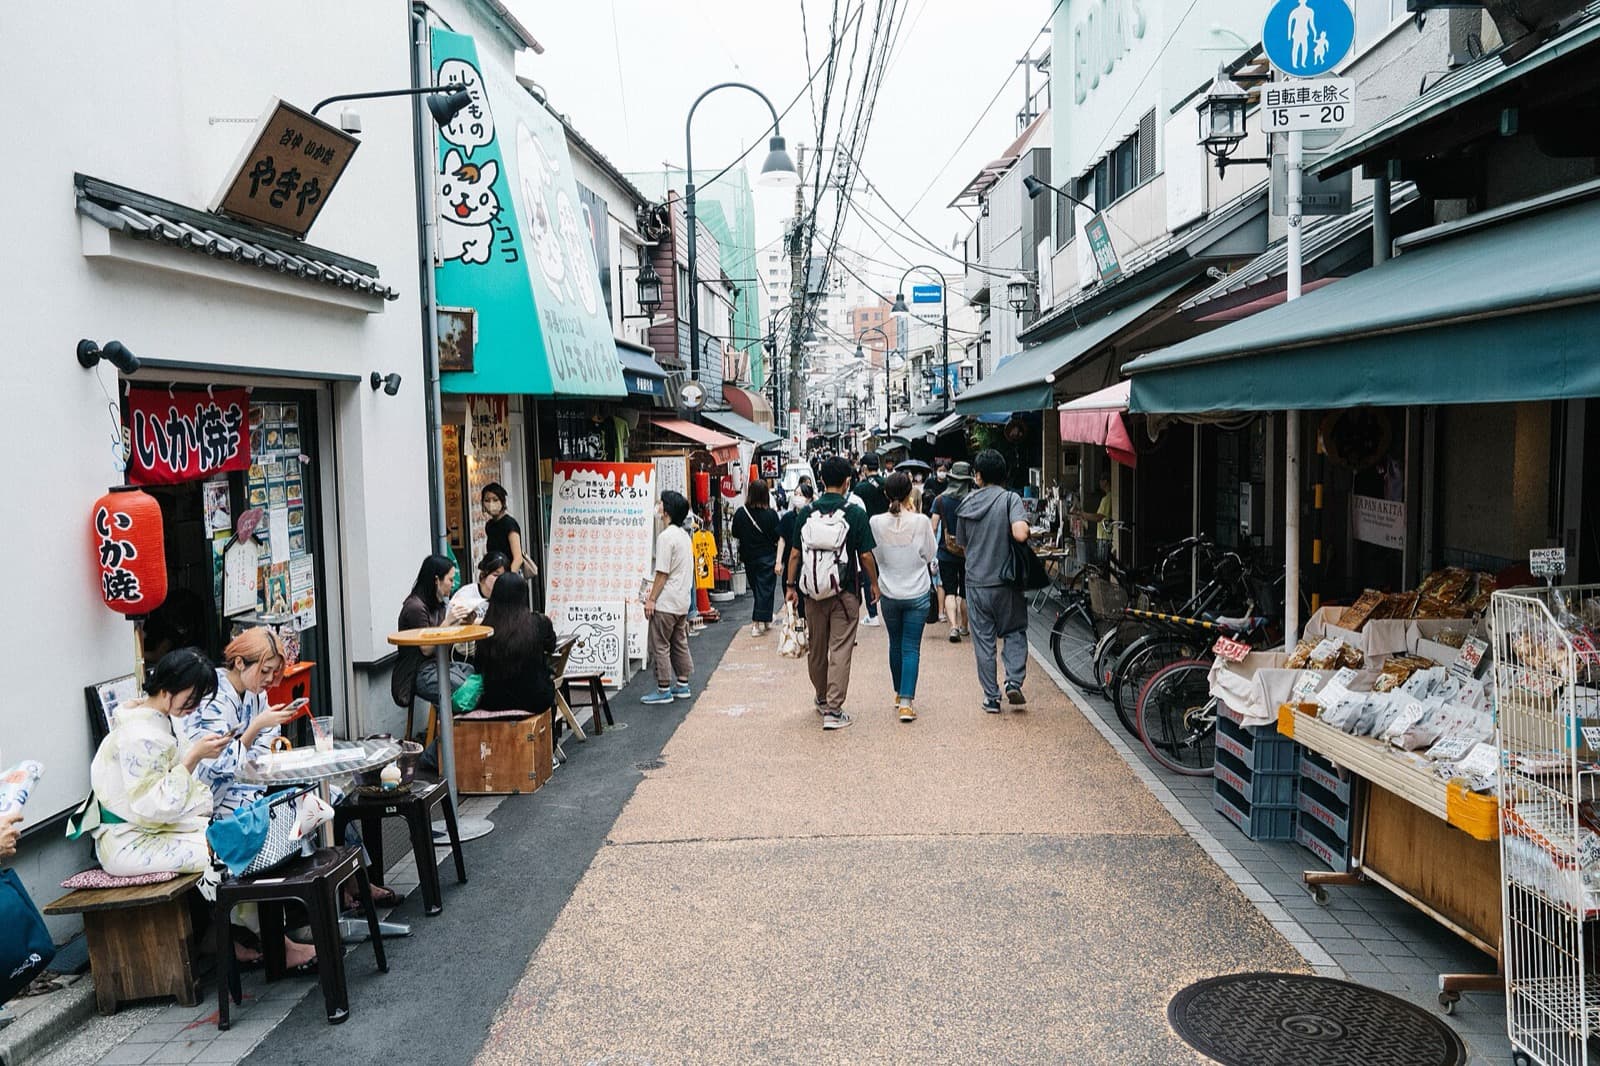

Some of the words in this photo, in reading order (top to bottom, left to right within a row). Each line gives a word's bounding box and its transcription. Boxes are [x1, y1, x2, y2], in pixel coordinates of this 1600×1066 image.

[461, 69, 485, 138] しにもの
[1267, 85, 1349, 106] 自転車を除く
[1272, 109, 1289, 126] 15
[1321, 105, 1344, 123] 20
[279, 127, 304, 150] 谷中
[249, 155, 322, 217] やきや
[134, 402, 244, 473] いか焼き
[763, 459, 777, 472] 氷
[577, 487, 648, 499] しにものぐるい
[96, 506, 144, 602] いか焼
[567, 612, 621, 621] しにものぐるい
